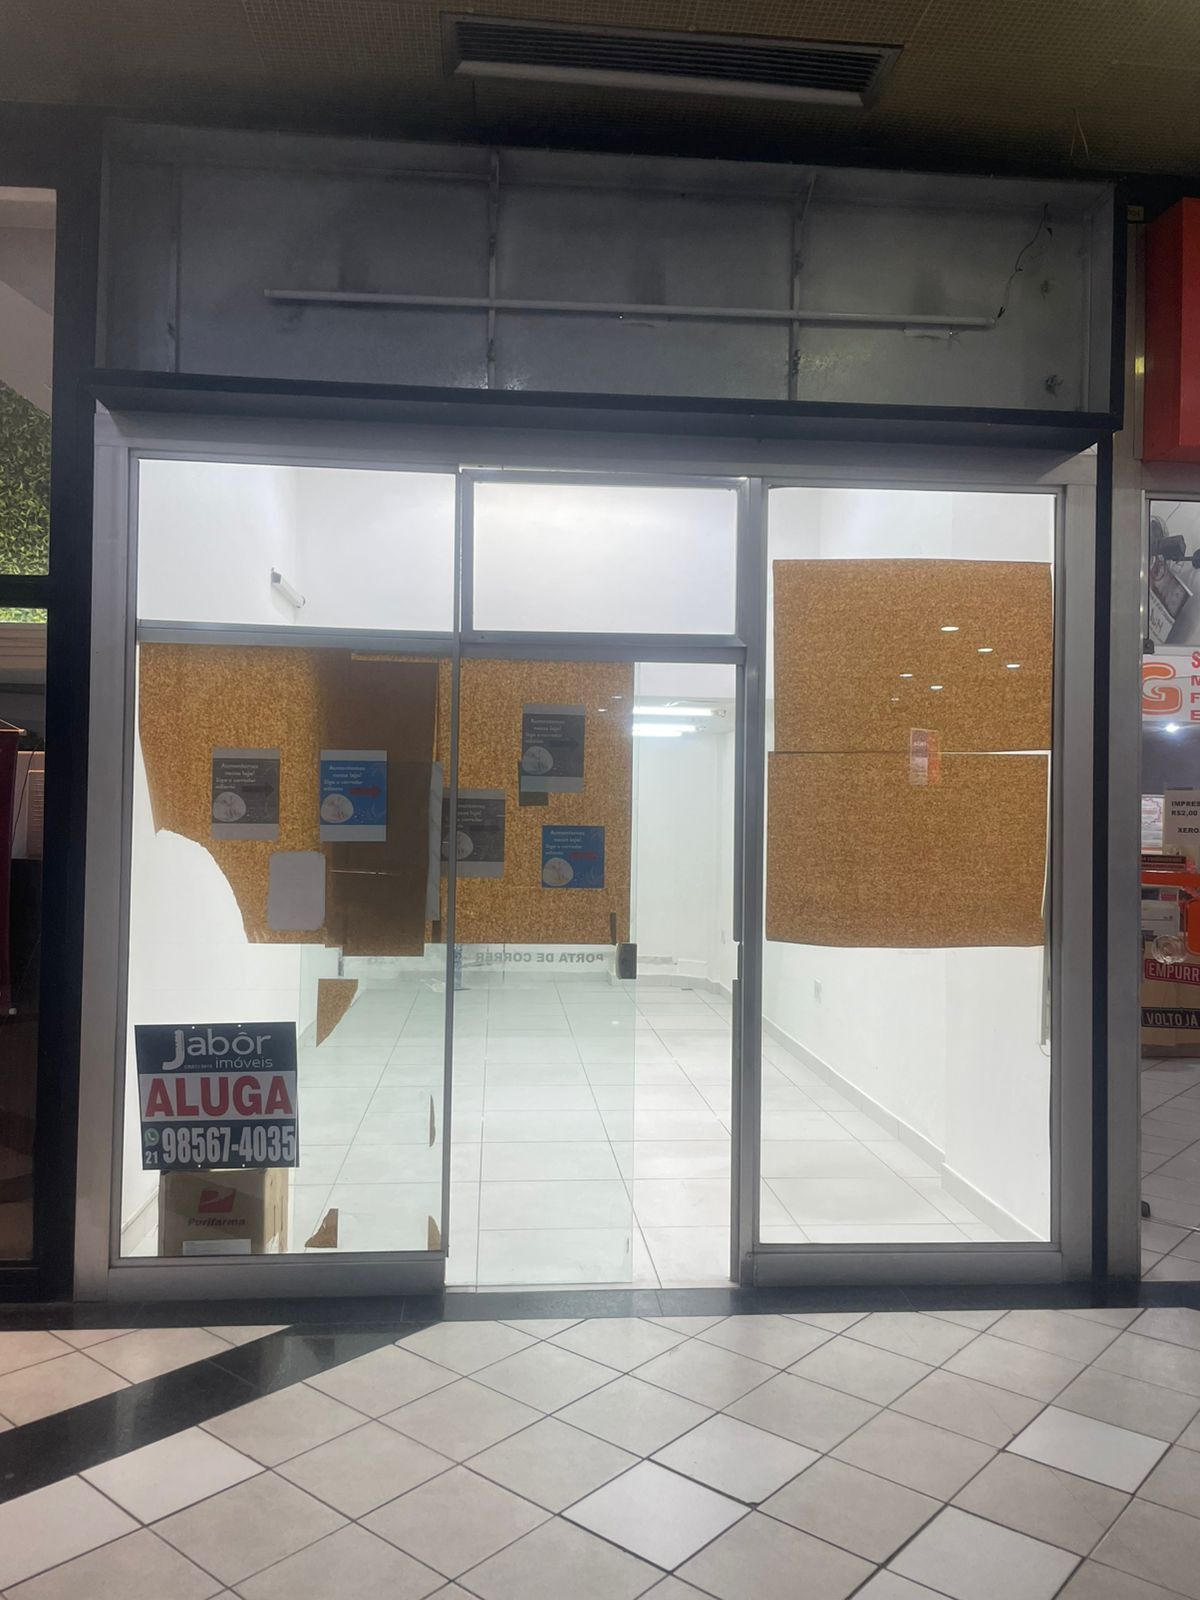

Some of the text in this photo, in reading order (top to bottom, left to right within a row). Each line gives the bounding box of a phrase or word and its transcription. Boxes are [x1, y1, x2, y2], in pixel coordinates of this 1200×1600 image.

[1146, 1012, 1182, 1026] VOLTO
[162, 1028, 272, 1071] Jabôr
[216, 1057, 273, 1069] imóveis
[145, 1075, 294, 1118] ALUGA
[145, 1125, 296, 1165] 21 98567-4035
